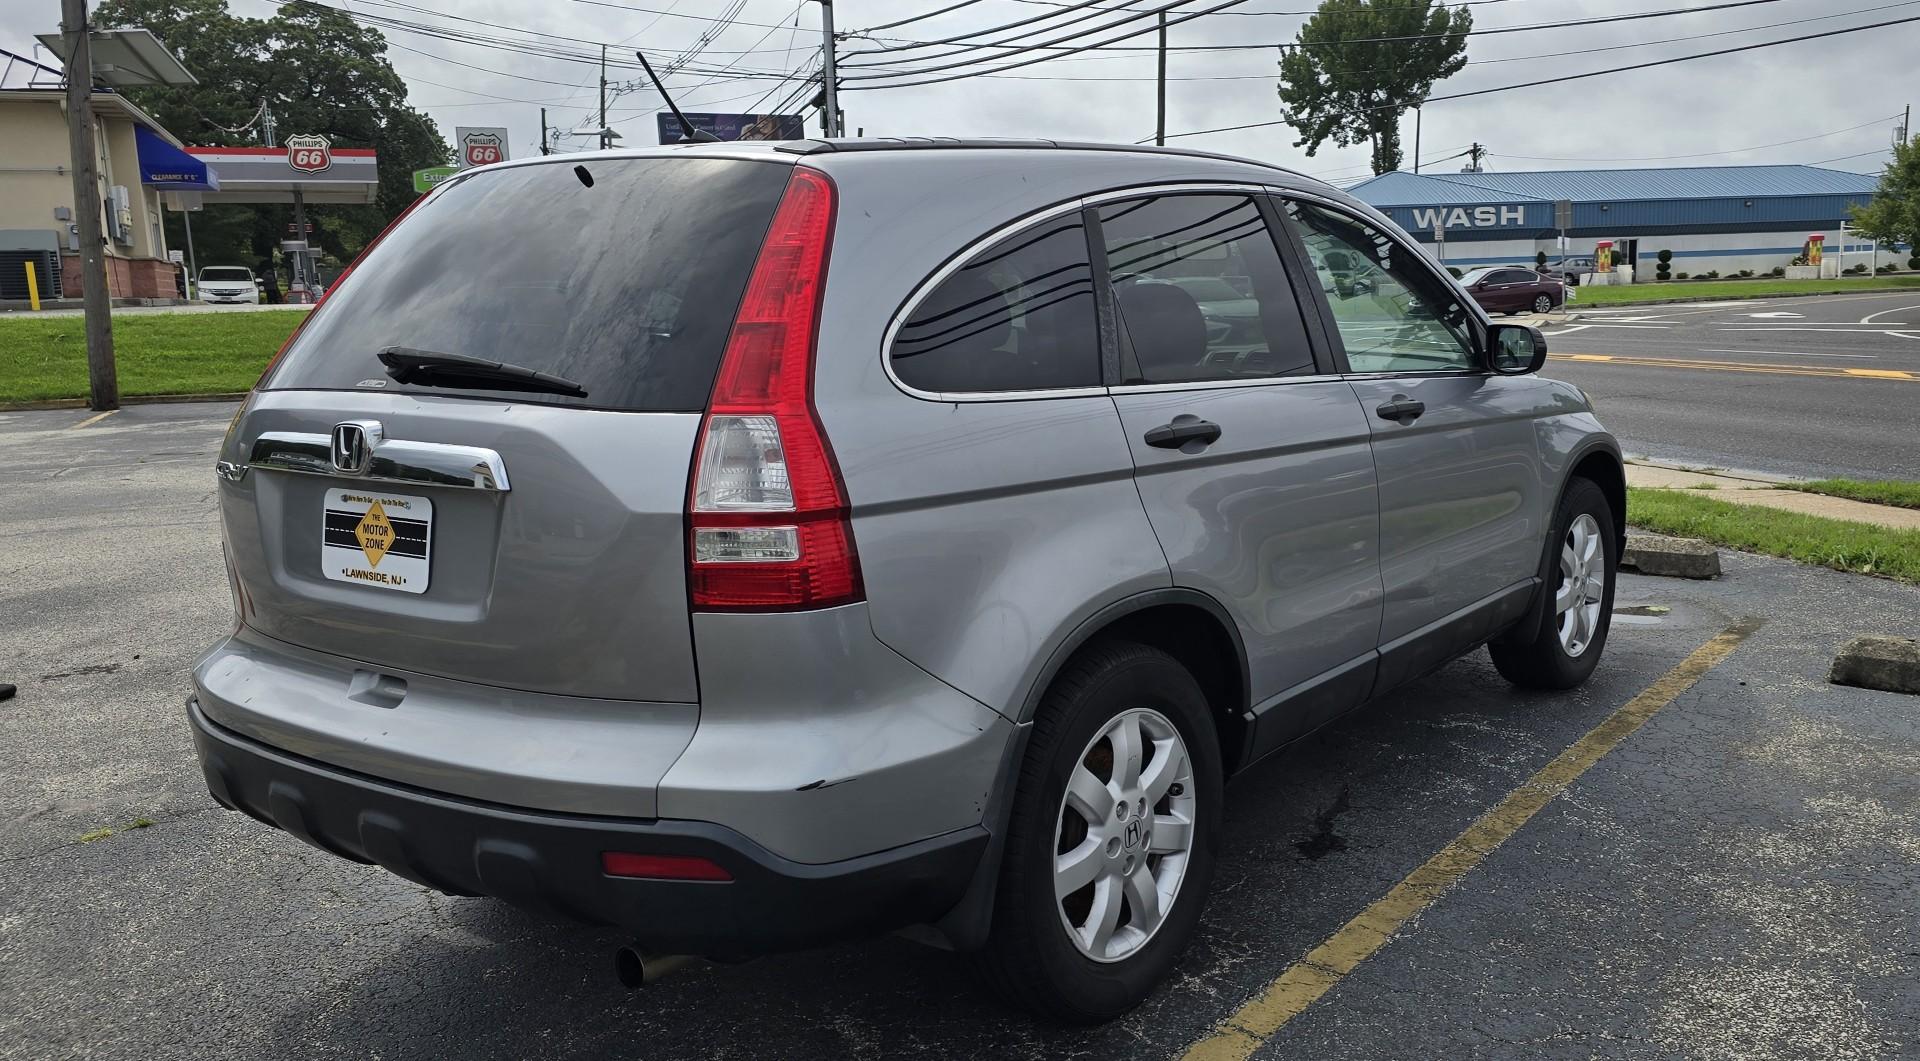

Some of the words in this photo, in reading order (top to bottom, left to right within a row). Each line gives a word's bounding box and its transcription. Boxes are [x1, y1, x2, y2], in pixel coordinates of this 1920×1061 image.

[297, 151, 322, 165] 66
[472, 148, 496, 161] 66
[1412, 206, 1524, 229] WASH
[362, 524, 388, 536] MOTOR
[366, 538, 384, 550] ZONE
[346, 568, 390, 584] LAWNSIDE,
[392, 576, 402, 585] NJ
